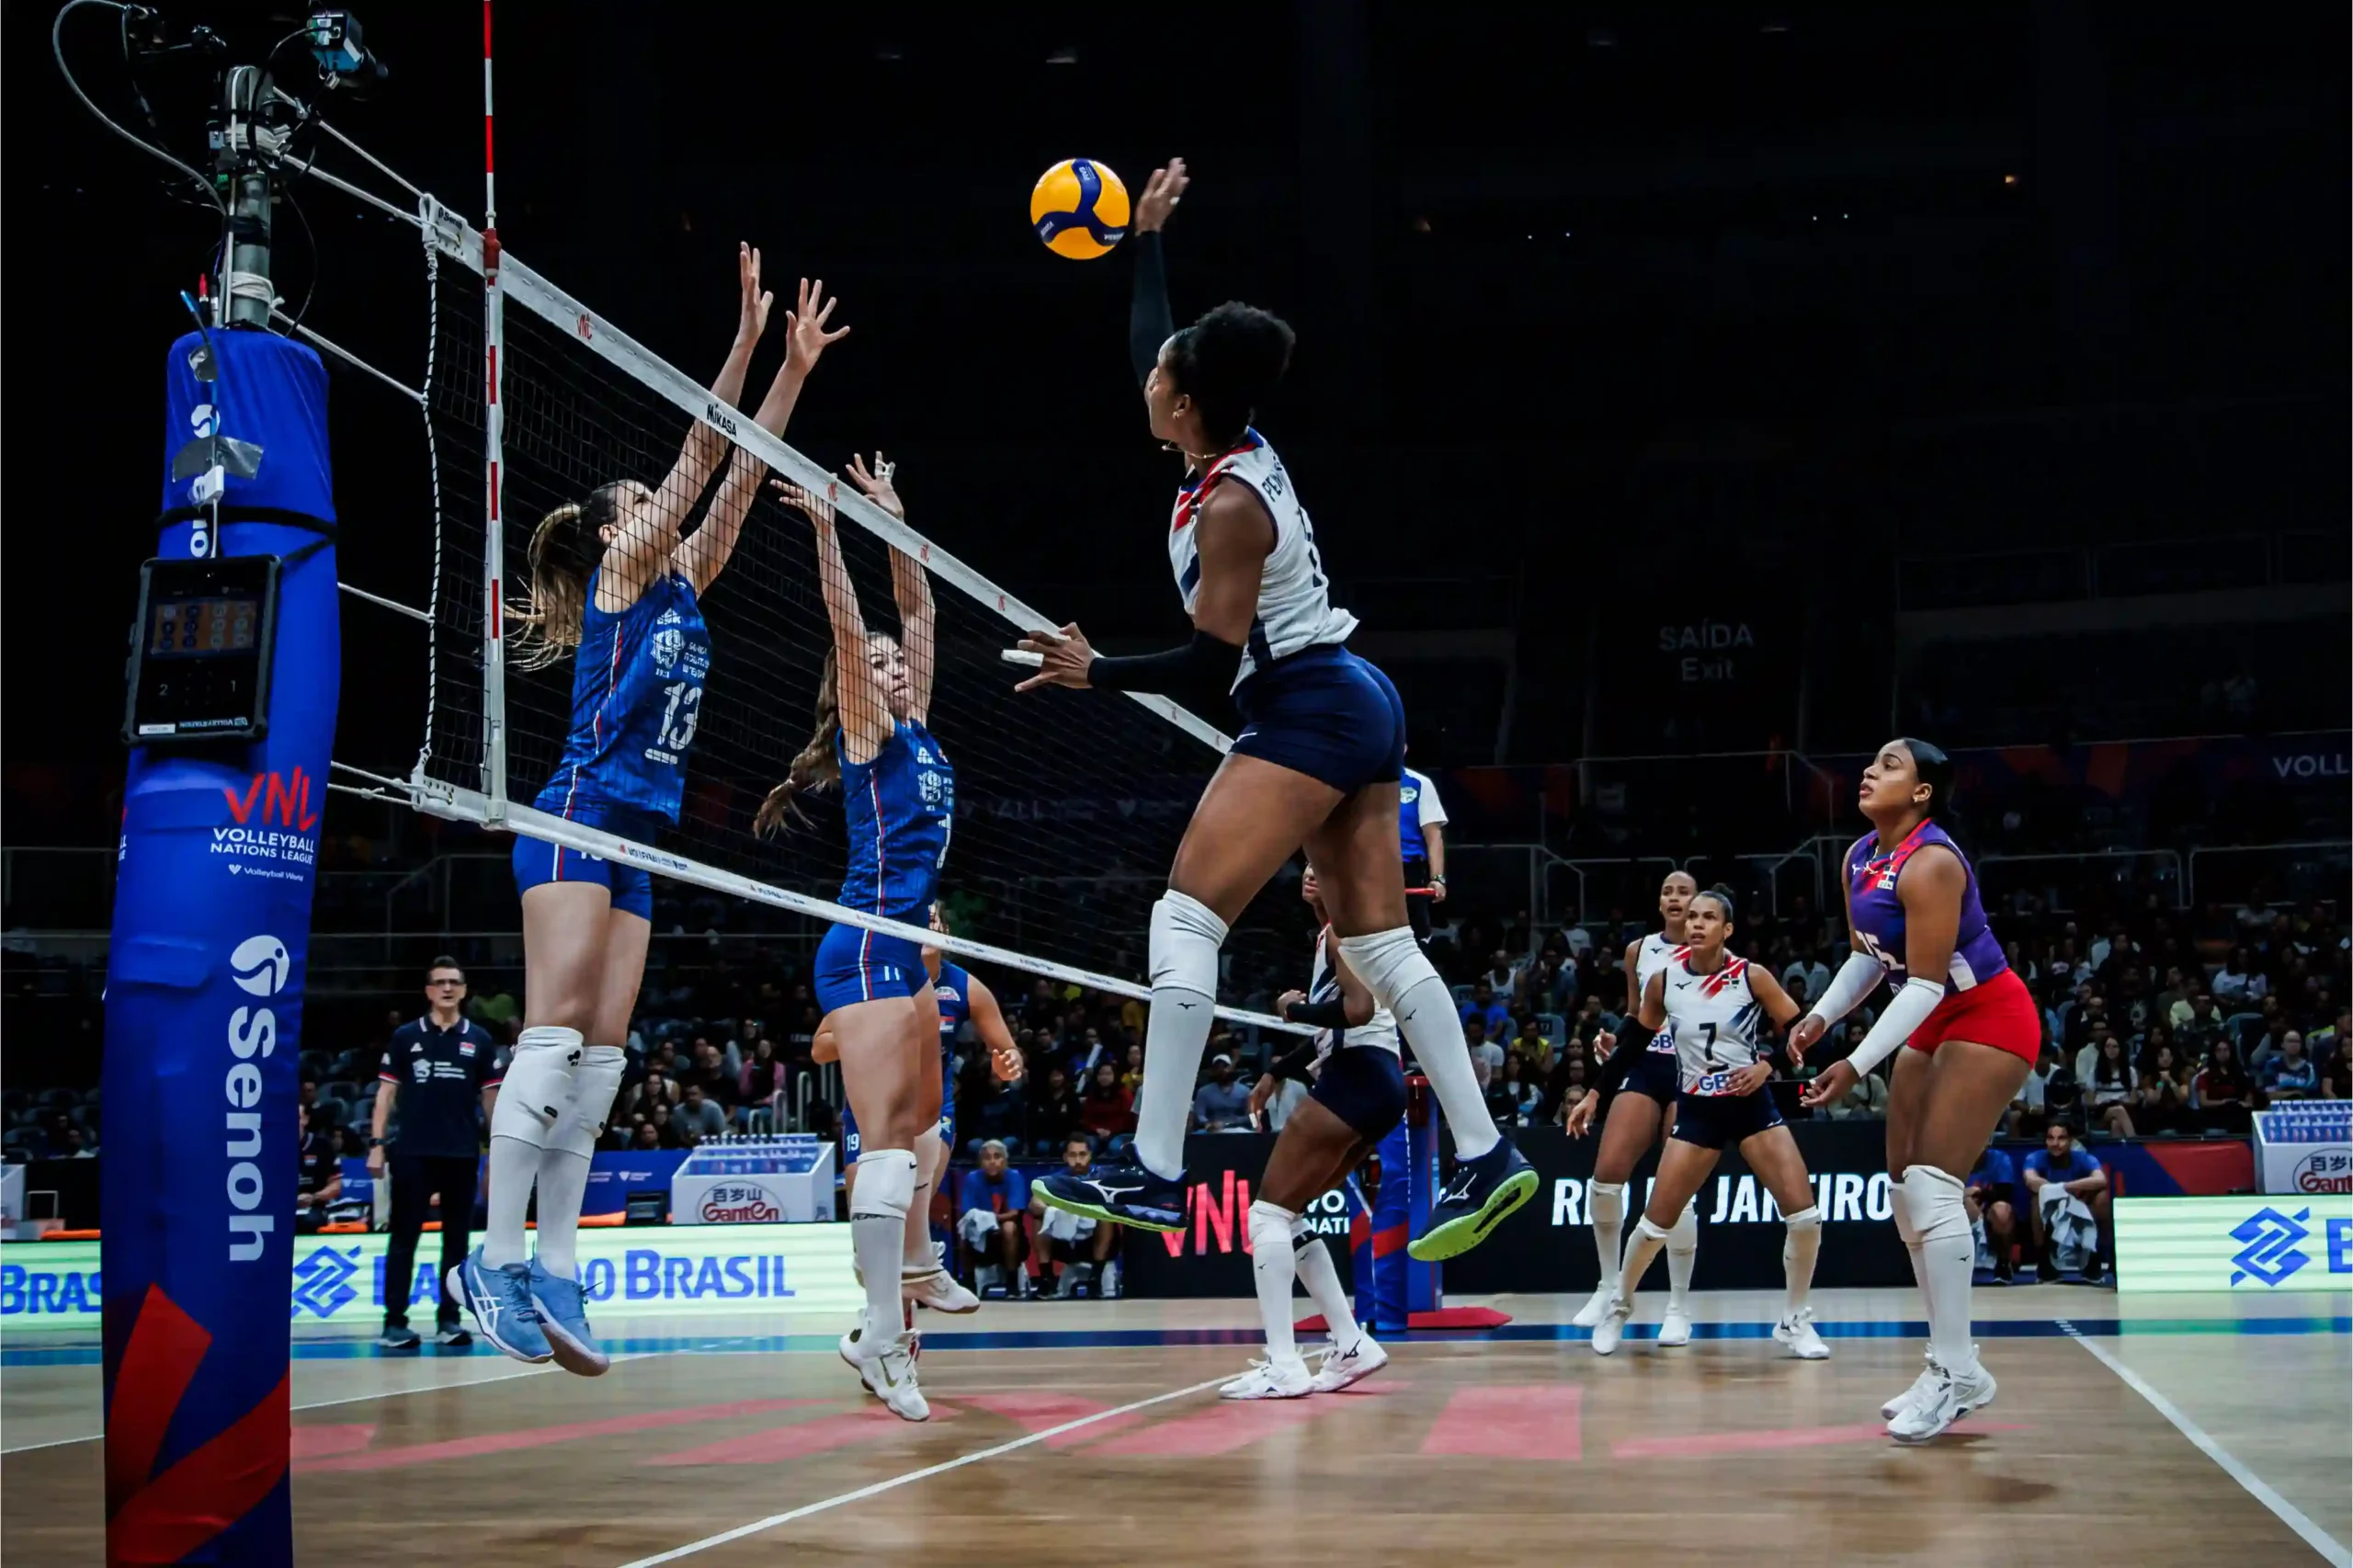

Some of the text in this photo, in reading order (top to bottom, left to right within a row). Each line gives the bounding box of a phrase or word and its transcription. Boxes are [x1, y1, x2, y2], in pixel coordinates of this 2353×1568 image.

[706, 403, 737, 437] MIKASA
[1658, 616, 1756, 652] SAÍDA
[1680, 656, 1737, 682] Exit
[158, 683, 168, 697] 2
[229, 679, 236, 693] 1
[657, 682, 702, 750] 13
[2271, 753, 2350, 778] VOLL
[224, 766, 317, 832] VNL
[210, 843, 313, 865] NATIONS LEAGUE
[213, 827, 314, 854] VOLLEYBALL
[244, 867, 284, 879] Volleyball
[1699, 1022, 1717, 1061] 7
[226, 1006, 276, 1261] Senoh
[847, 1132, 859, 1152] 19
[712, 1187, 762, 1202] 百岁山
[1711, 1173, 1894, 1223] JANIRO
[625, 1249, 796, 1301] BRASIL
